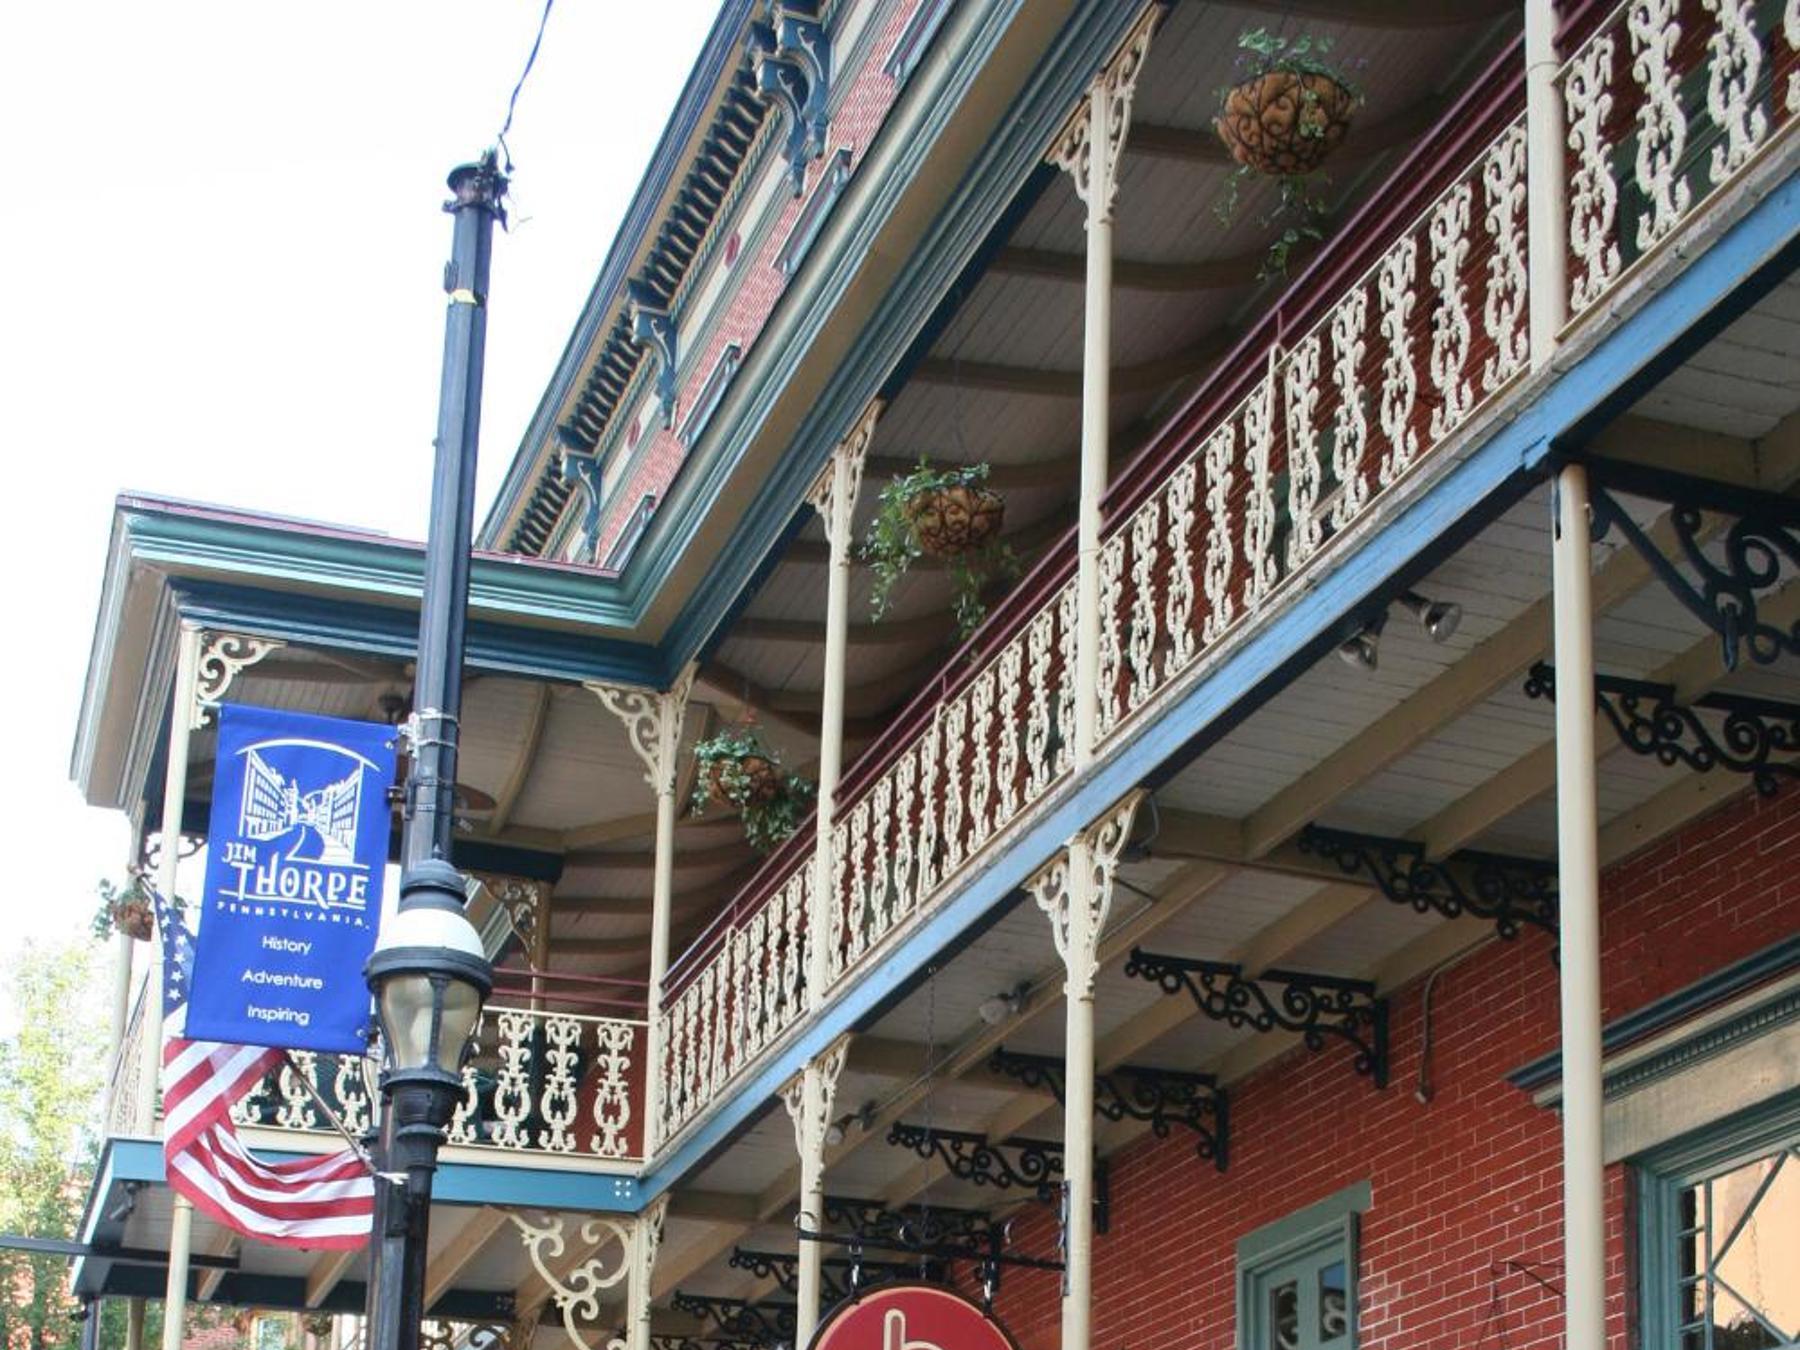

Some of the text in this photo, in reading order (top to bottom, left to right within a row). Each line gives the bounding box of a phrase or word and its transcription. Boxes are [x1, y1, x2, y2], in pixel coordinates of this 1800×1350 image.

[221, 843, 256, 863] JIM
[229, 852, 370, 909] THORPE
[262, 936, 312, 955] History
[242, 969, 323, 989] Adventure
[248, 1005, 310, 1026] Inspiring
